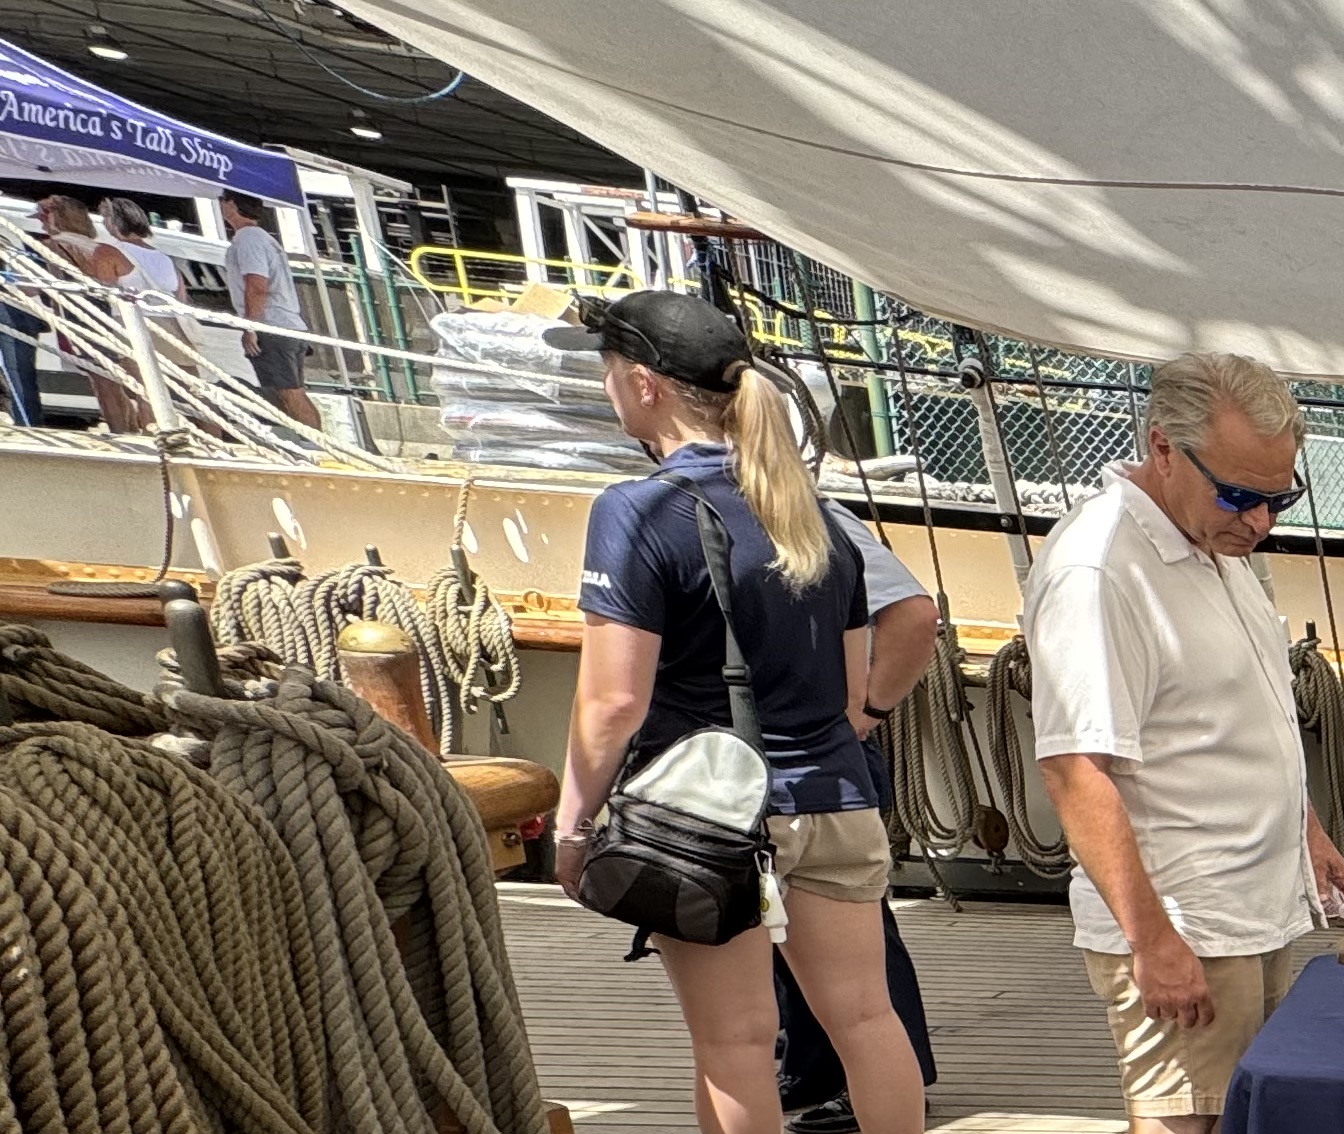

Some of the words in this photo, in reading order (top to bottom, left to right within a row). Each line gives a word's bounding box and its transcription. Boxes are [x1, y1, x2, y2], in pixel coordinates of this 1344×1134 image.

[0, 90, 123, 139] America's
[126, 118, 176, 156] Tall
[180, 136, 234, 180] Ship
